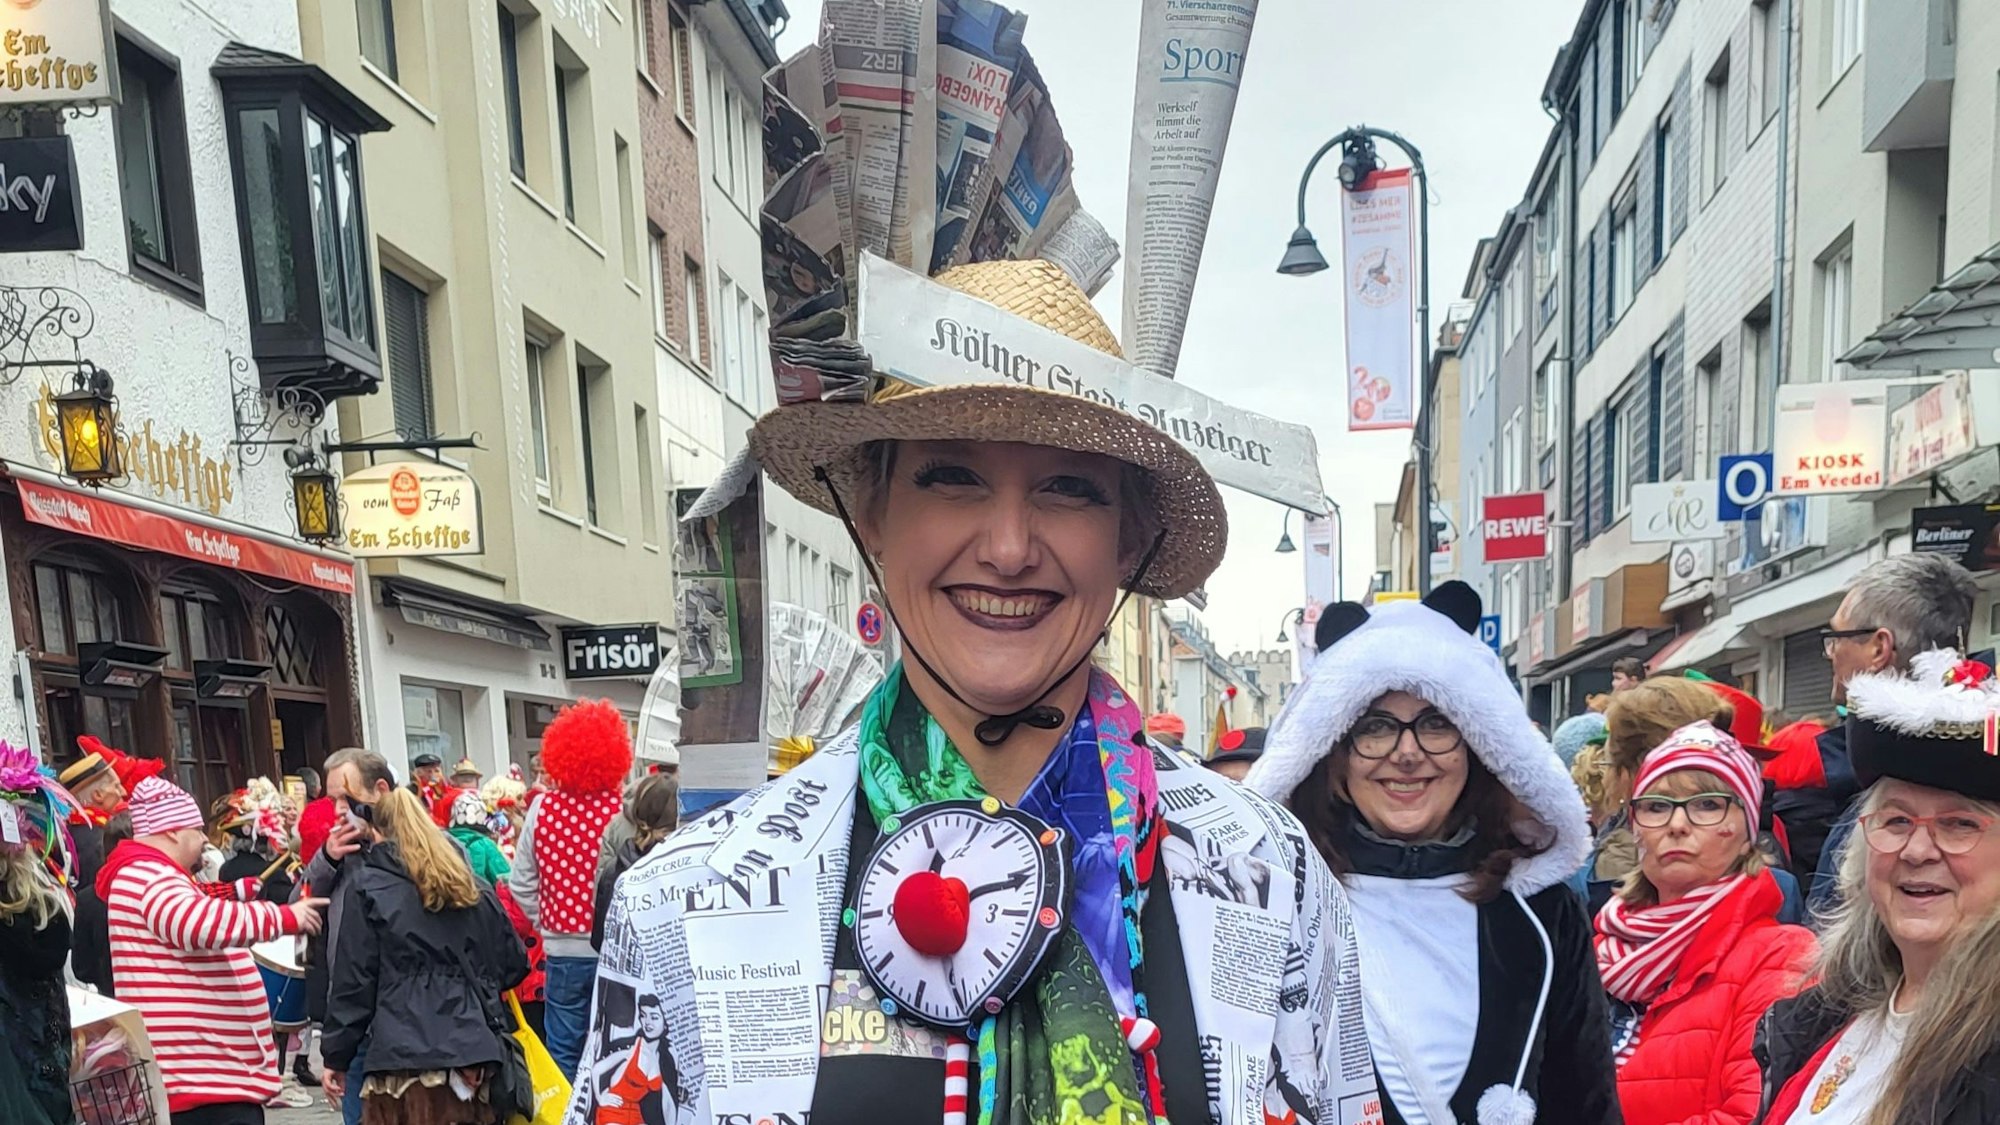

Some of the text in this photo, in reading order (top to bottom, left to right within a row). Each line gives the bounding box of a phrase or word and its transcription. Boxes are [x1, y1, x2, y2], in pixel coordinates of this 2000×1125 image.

[4, 29, 51, 56] Em
[1164, 38, 1245, 79] Sport
[1158, 101, 1198, 113] Werkself
[1156, 115, 1201, 127] nimmt die
[1155, 128, 1200, 139] Arbeit auf
[930, 318, 1041, 386] Kölner
[1138, 403, 1273, 467] Anzeiger
[116, 411, 233, 515] cheffge
[1798, 454, 1864, 470] KIOSK
[1781, 471, 1880, 490] Em Veedel
[363, 499, 388, 509] vom
[424, 489, 460, 511] Faß
[349, 525, 470, 549] Em Scheffge
[1485, 516, 1545, 539] REWE
[1916, 527, 1974, 543] Berliner
[567, 635, 655, 672] Frisör
[1159, 784, 1217, 812] imes
[1208, 821, 1243, 840] FARE
[662, 856, 692, 872] CRUZ
[625, 896, 656, 912] U.S.
[985, 903, 999, 924] 3
[1307, 902, 1322, 939] Other
[692, 960, 801, 981] Music Festival
[822, 1005, 886, 1043] cke
[1246, 1054, 1256, 1091] FARE
